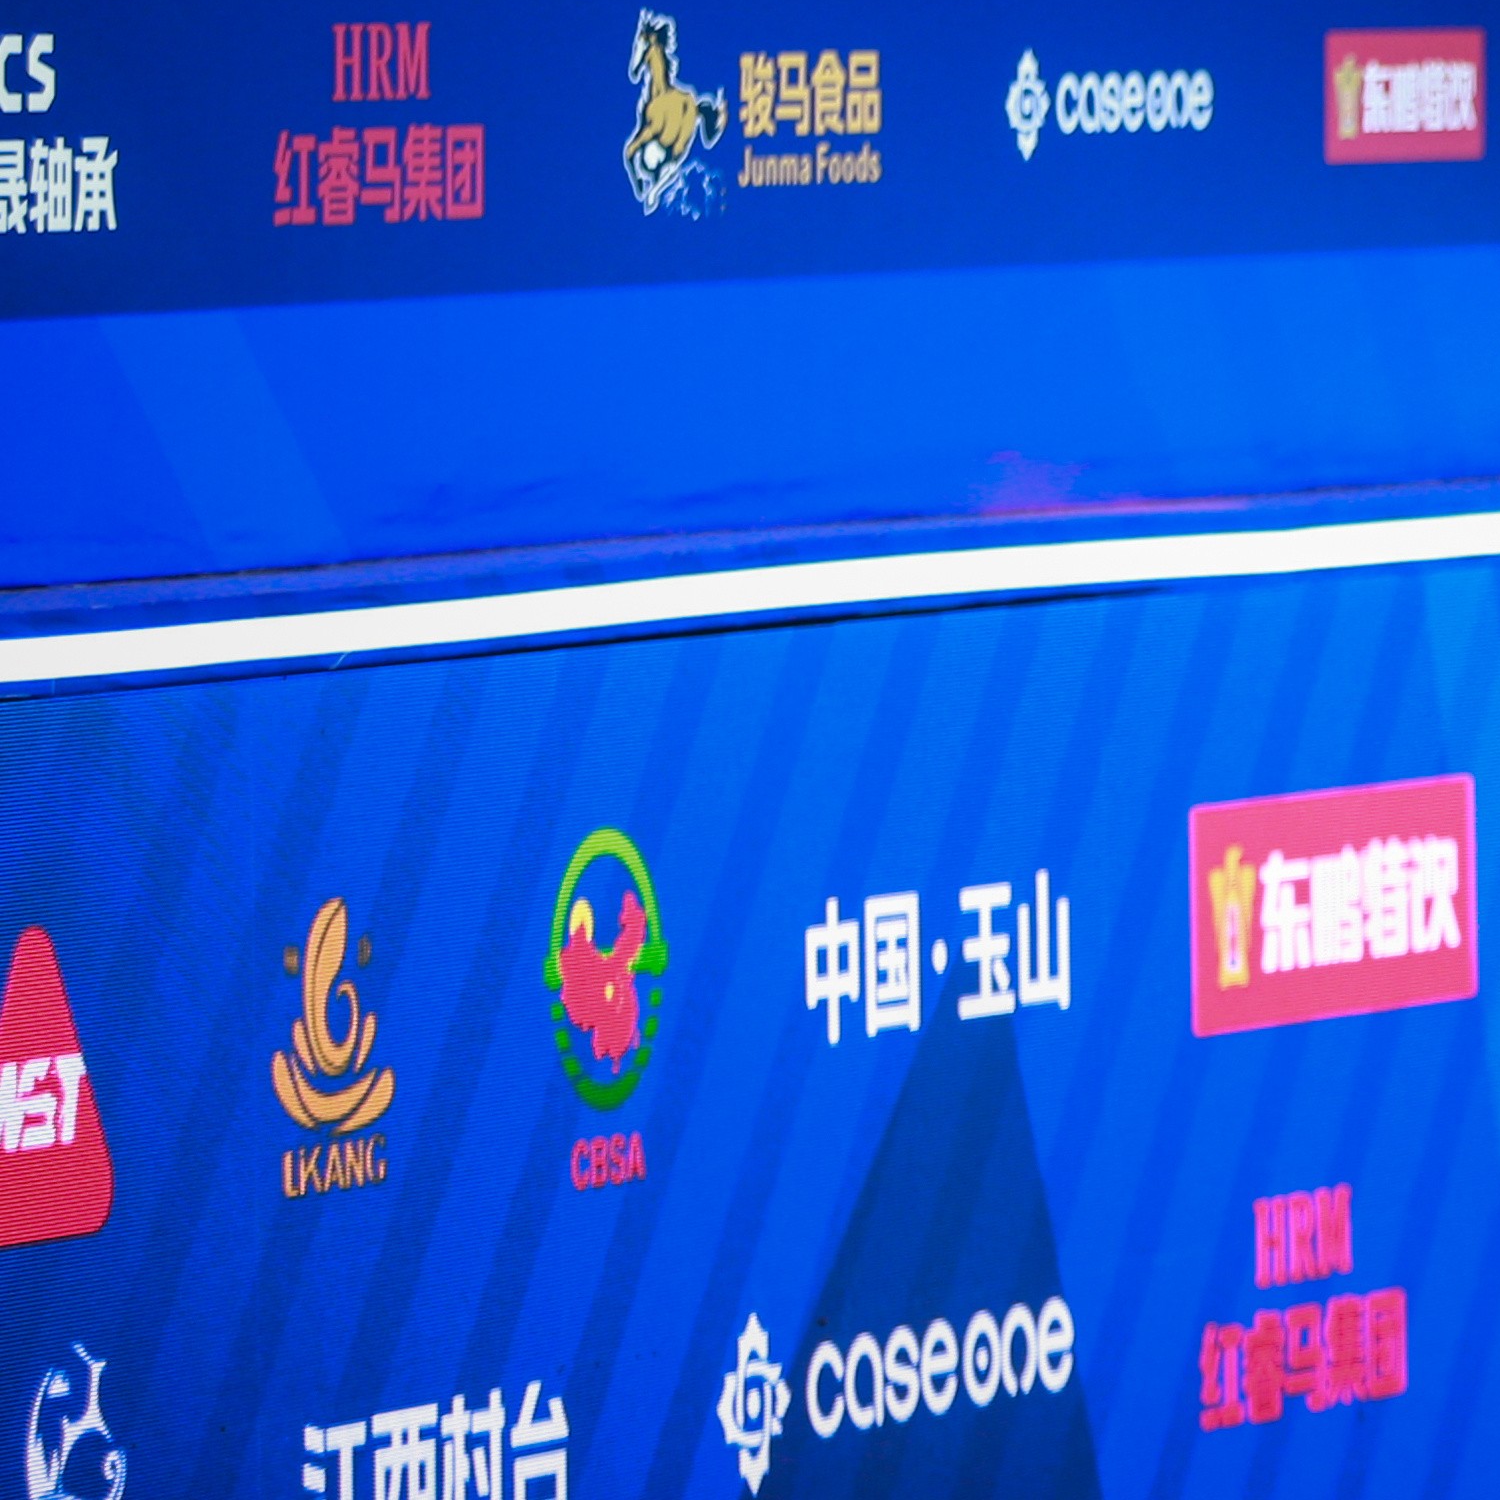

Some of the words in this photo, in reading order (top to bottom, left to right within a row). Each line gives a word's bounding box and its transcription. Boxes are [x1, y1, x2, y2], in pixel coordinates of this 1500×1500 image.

[331, 21, 431, 102] HRM
[739, 48, 883, 138] 骏马食品
[273, 123, 485, 227] 红睿马集团
[738, 144, 812, 188] Junma
[816, 141, 882, 186] Foods
[570, 1130, 647, 1191] CBSA
[1254, 1182, 1353, 1291] HRM
[806, 1295, 1074, 1438] caseone
